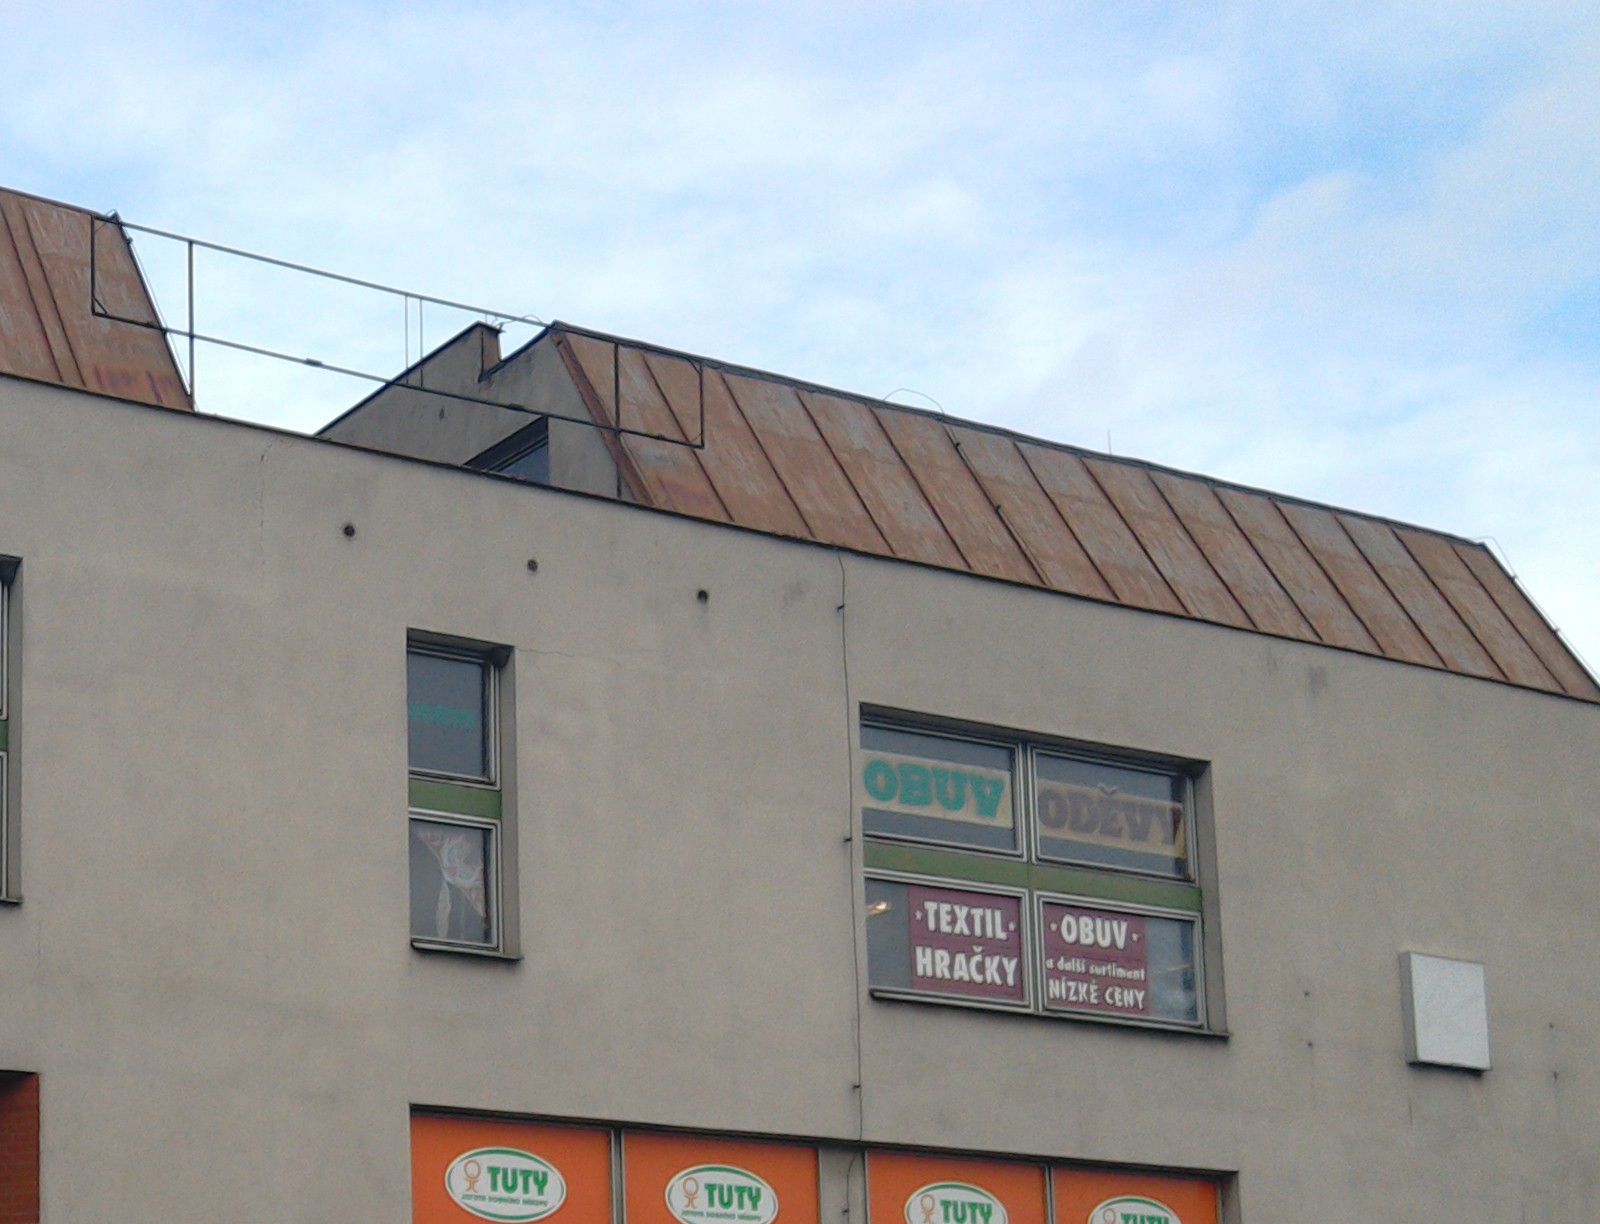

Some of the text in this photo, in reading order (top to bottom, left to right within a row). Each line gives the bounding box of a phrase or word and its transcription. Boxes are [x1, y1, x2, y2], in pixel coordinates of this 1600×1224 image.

[863, 759, 1007, 819] OBUV
[1037, 782, 1183, 847] ODĚVY
[924, 901, 1008, 941] TEXTIL
[1060, 914, 1128, 950] OBUV
[915, 945, 1018, 987] HRAČKY
[1048, 976, 1145, 1010] NÍZKÉ CENY
[487, 1166, 548, 1196] TUTY
[704, 1183, 761, 1211] TUTY
